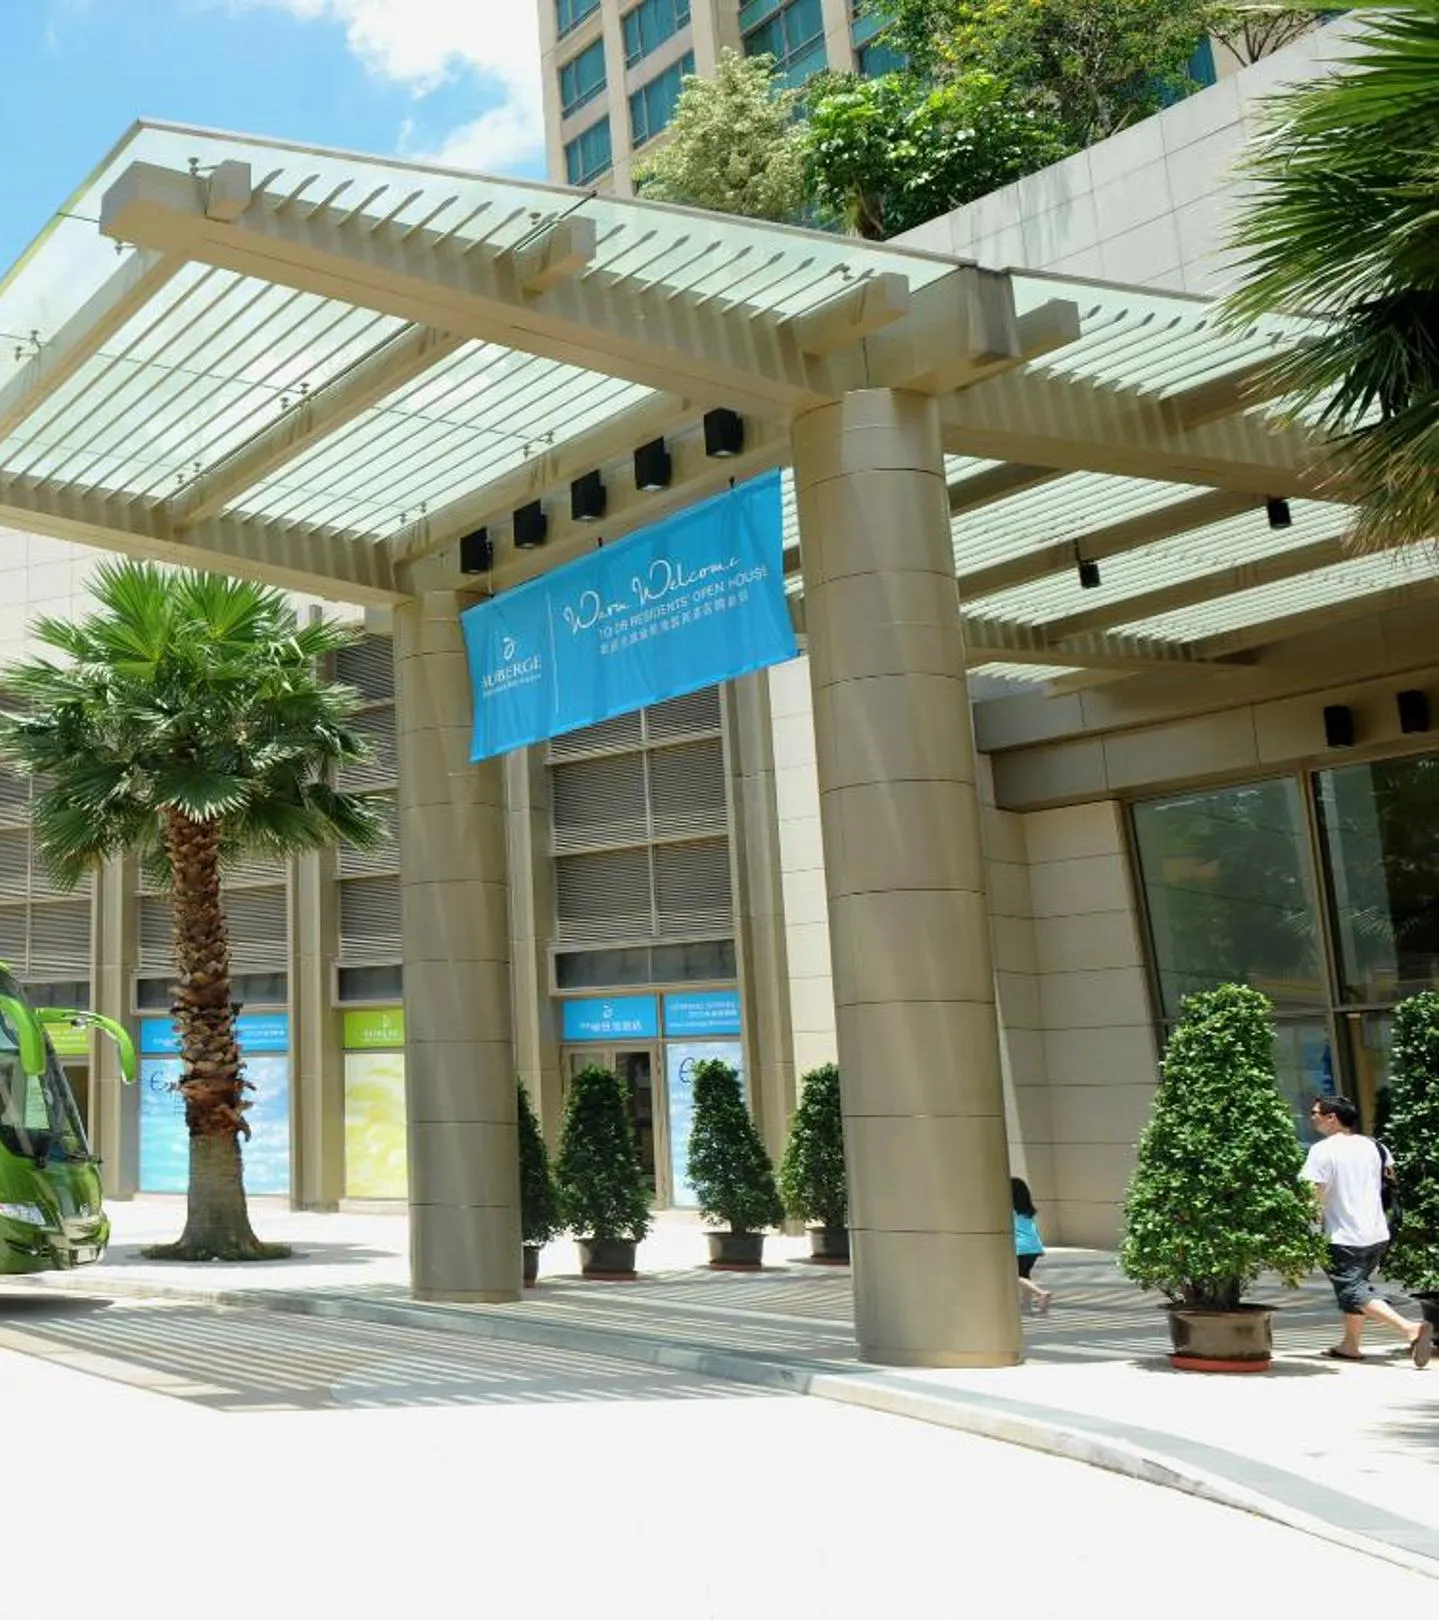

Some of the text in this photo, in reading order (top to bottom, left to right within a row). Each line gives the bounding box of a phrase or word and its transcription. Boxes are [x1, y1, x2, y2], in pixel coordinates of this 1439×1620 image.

[632, 556, 740, 606] Welcome
[692, 581, 725, 602] OPEN
[728, 564, 767, 588] HOUSE
